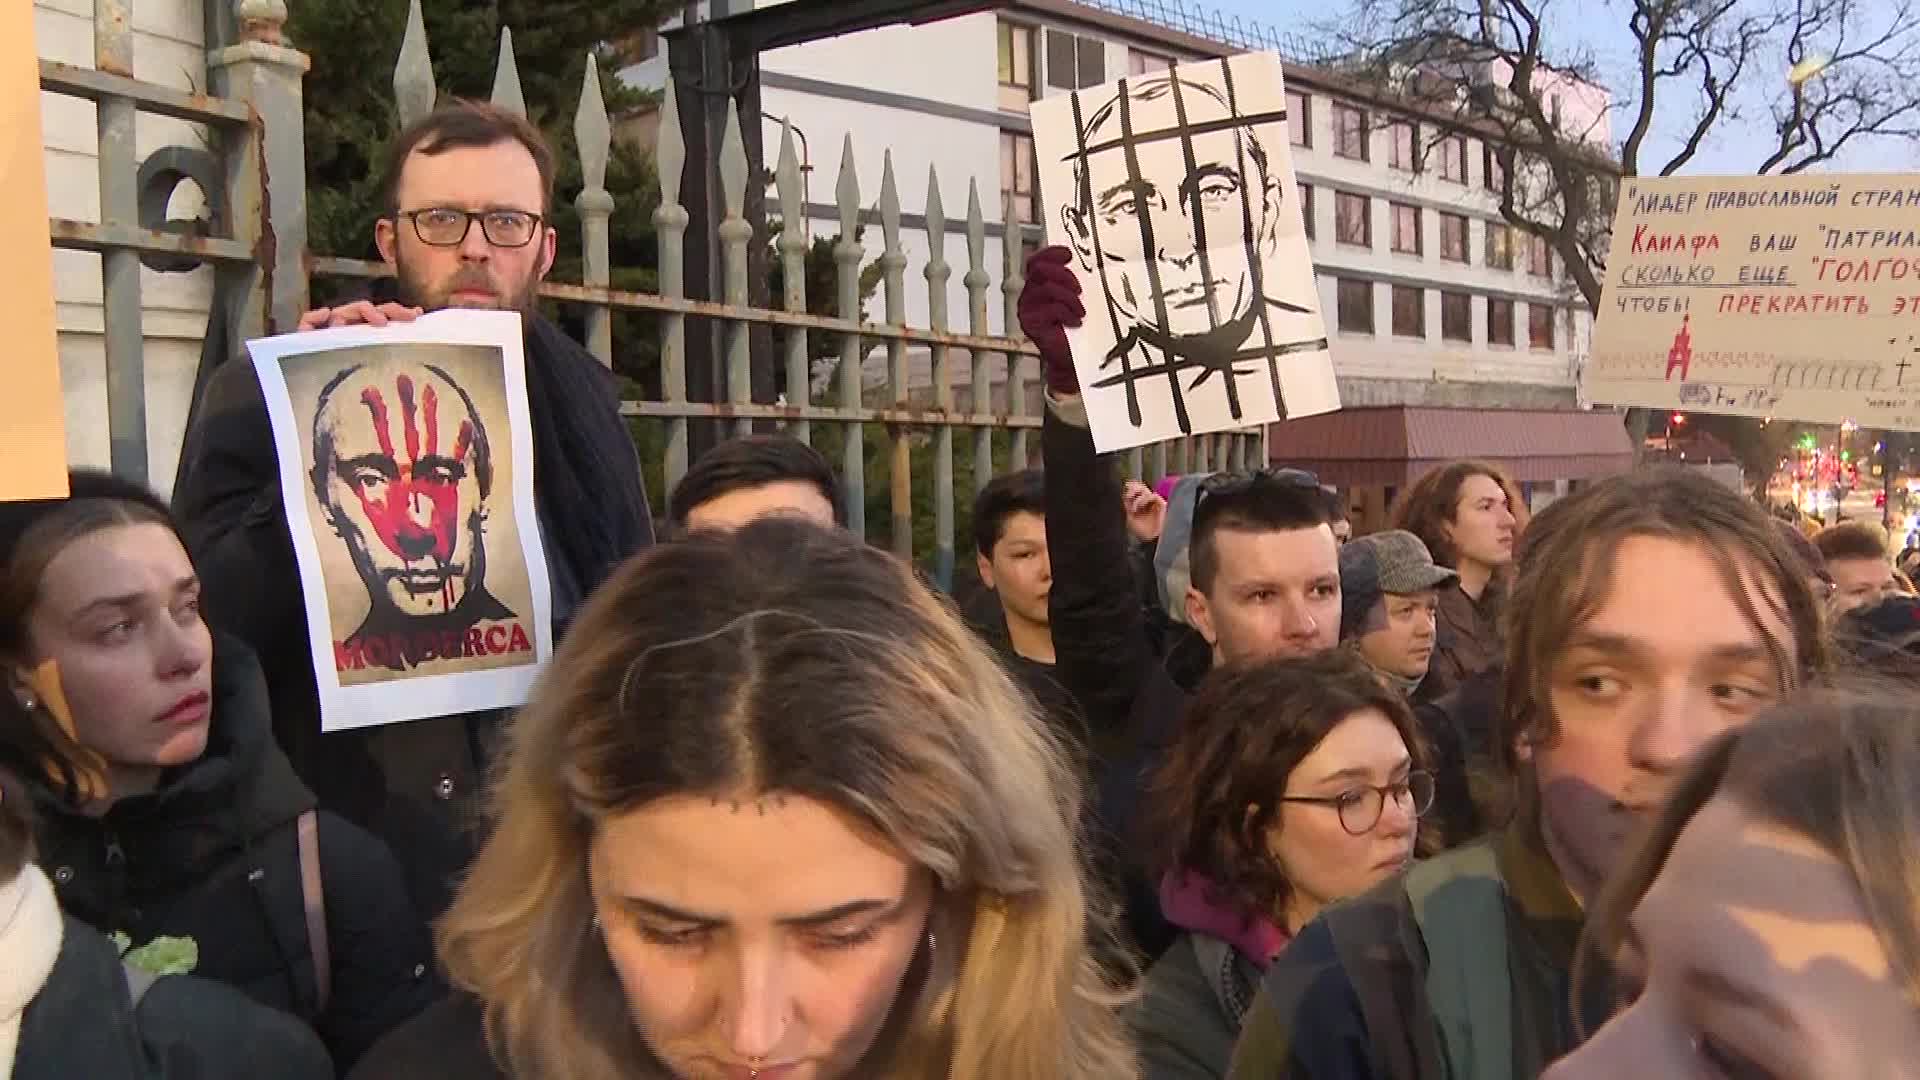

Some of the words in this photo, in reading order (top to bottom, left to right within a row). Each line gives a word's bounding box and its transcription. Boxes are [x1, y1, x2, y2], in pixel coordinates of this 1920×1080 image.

[1629, 186, 1698, 216] "ЛИДЕР
[1705, 184, 1840, 210] ПРАВОСЛАВНОЙ
[1750, 233, 1797, 252] ВАШ
[1819, 223, 1920, 249] "ПАТРИА
[1621, 264, 1715, 286] СКОЛЬКО
[1738, 265, 1789, 285] ЕЩЕ
[1617, 295, 1690, 313] ЧТОБЫ
[1719, 294, 1869, 314] ПРЕКРАТИТЬ
